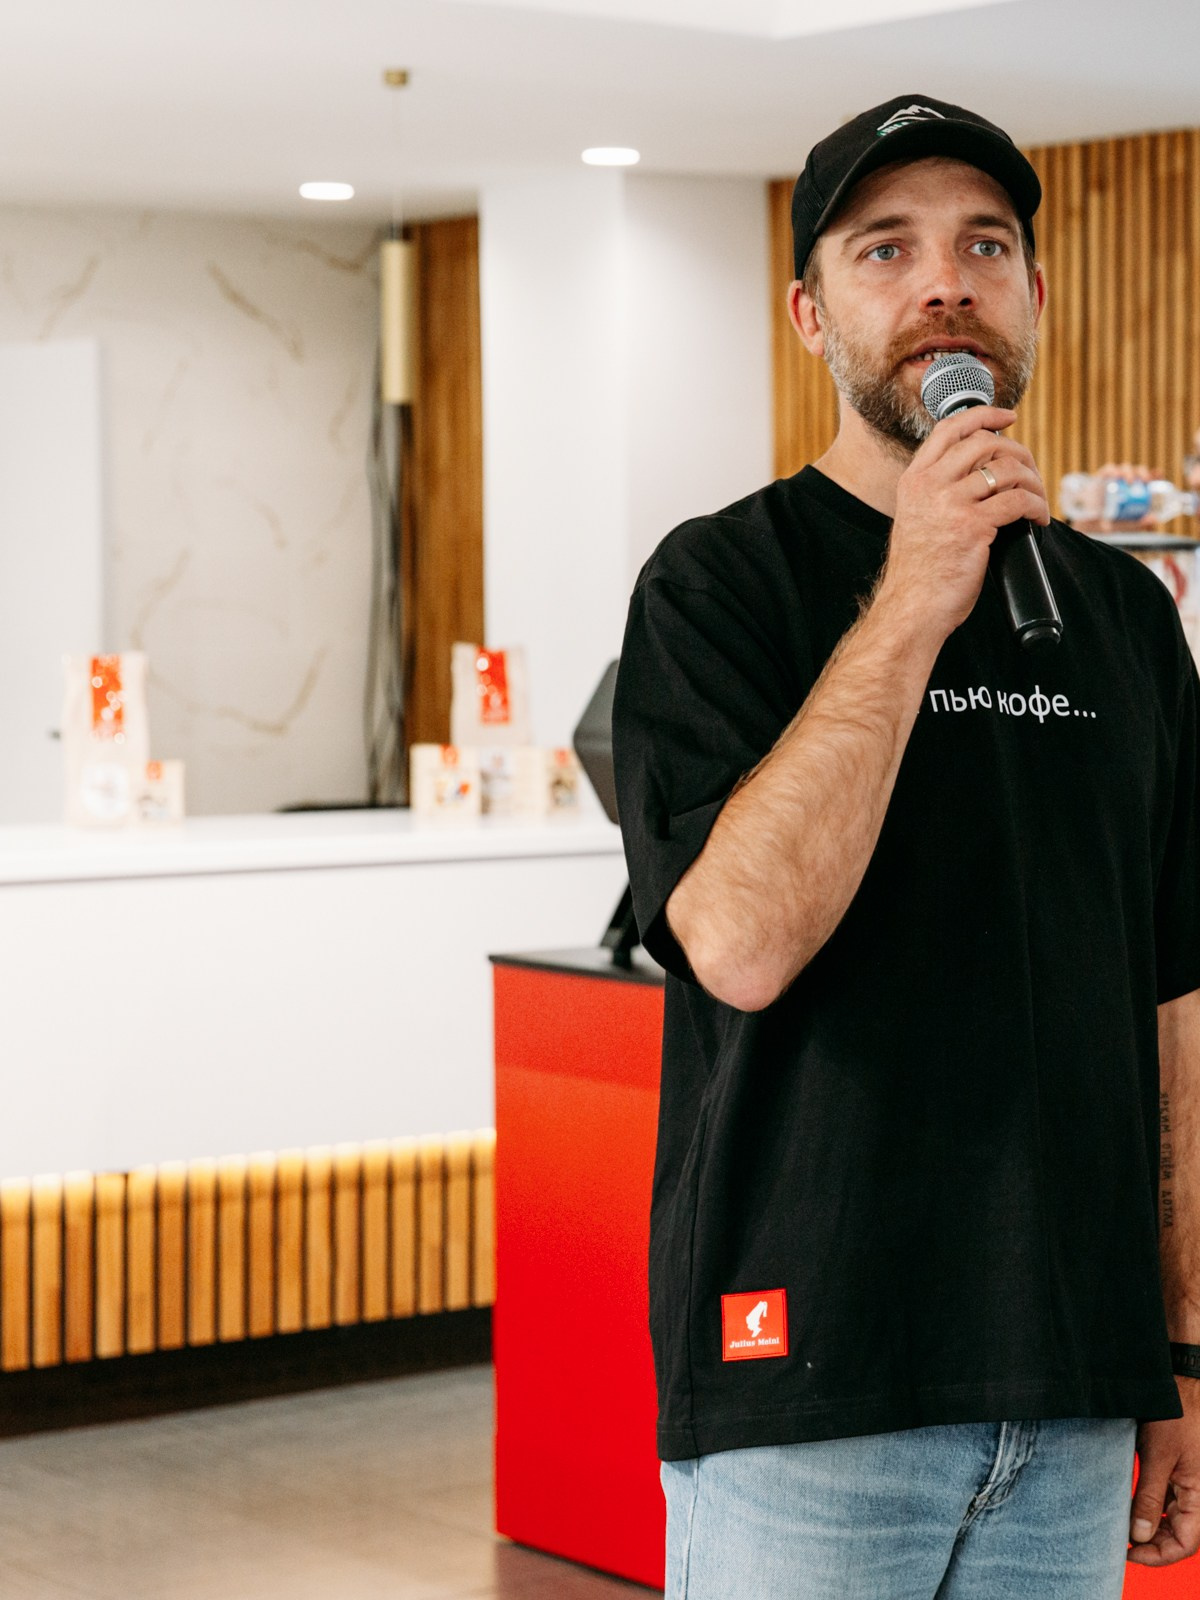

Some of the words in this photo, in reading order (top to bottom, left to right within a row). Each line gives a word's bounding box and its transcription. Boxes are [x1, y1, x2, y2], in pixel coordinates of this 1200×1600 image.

[929, 685, 993, 713] пью
[996, 684, 1097, 724] кофе...
[729, 1339, 756, 1349] Julius
[757, 1336, 780, 1346] Meinl
